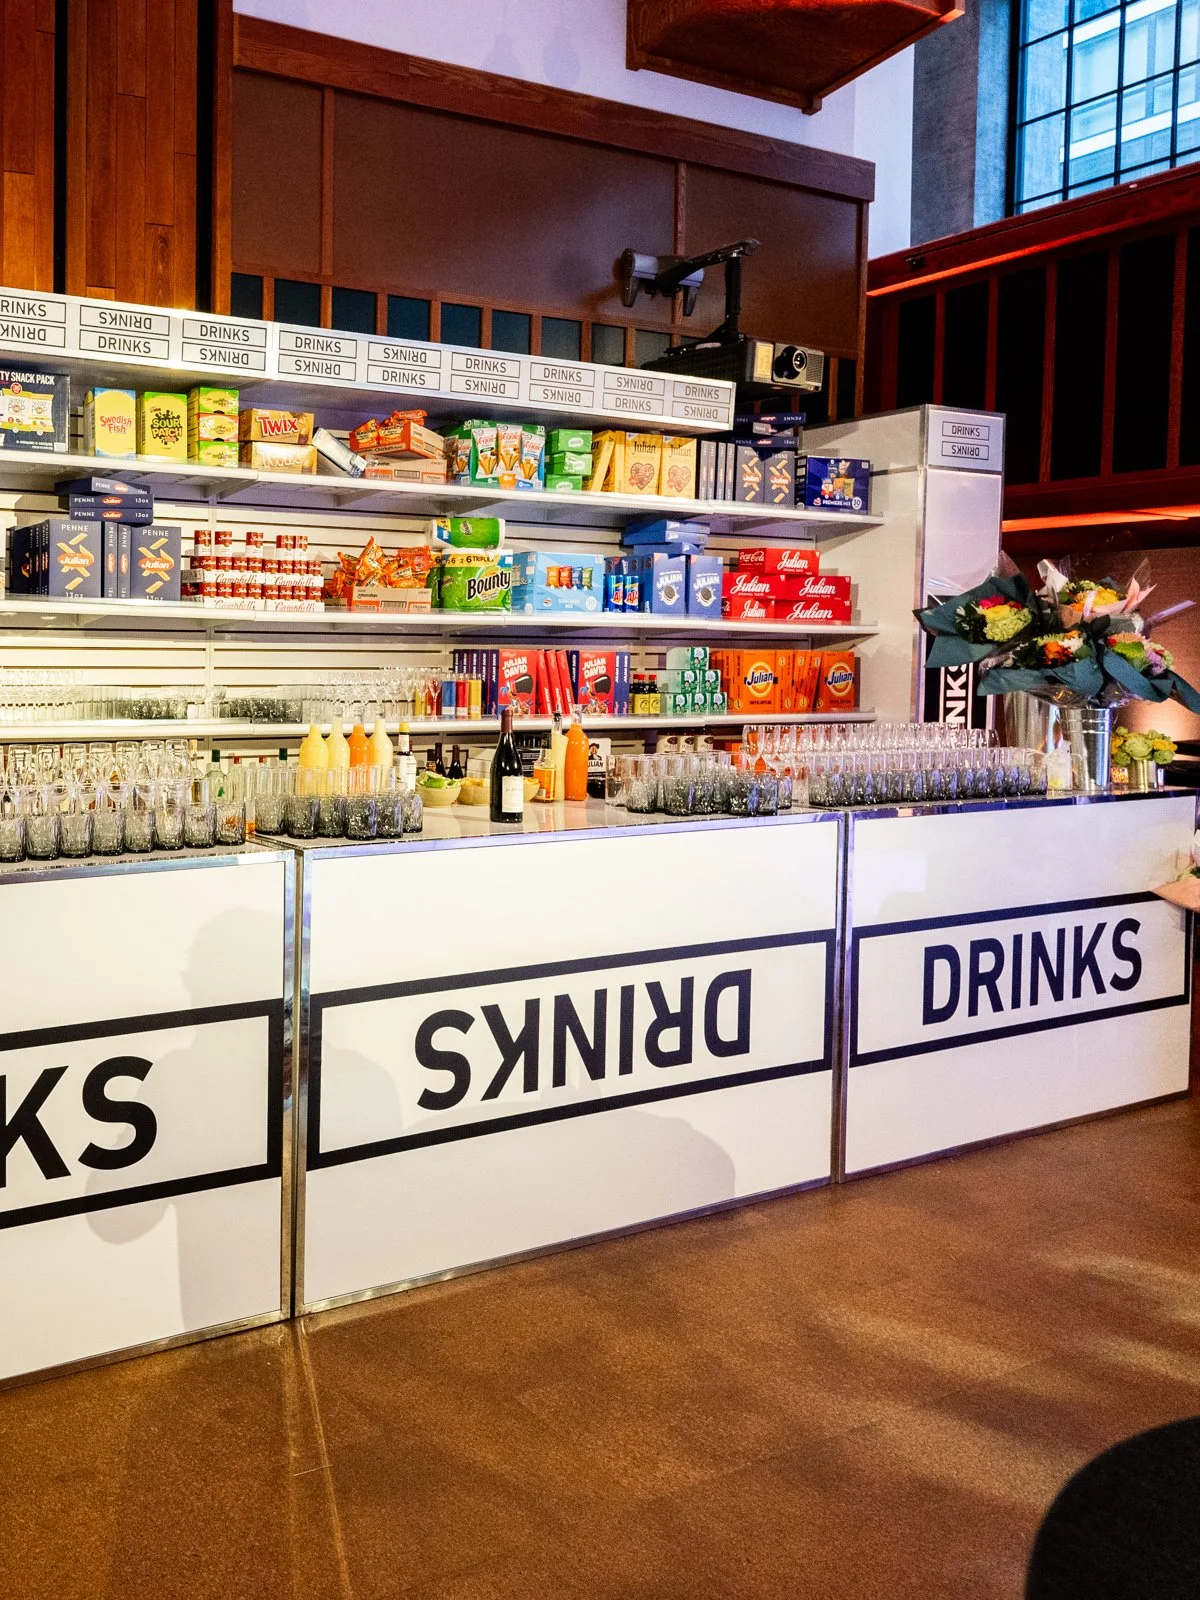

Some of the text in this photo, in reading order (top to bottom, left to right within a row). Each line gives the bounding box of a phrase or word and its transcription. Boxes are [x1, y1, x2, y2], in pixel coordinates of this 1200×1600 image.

[98, 311, 152, 330] DRINKS
[199, 324, 250, 342] DRINKS
[97, 335, 151, 354] DRINKS
[295, 336, 342, 353] DRINKS
[199, 347, 250, 365] DRINKS
[383, 347, 427, 364] DRINKS
[294, 359, 341, 376] DRINKS
[465, 357, 507, 373] DRINKS
[11, 372, 35, 383] SNACK
[36, 375, 55, 385] PACK
[382, 369, 426, 386] DRINKS
[543, 367, 582, 383] DRINKS
[464, 379, 506, 395] DRINKS
[616, 376, 653, 392] DRINKS
[542, 388, 581, 403] DRINKS
[684, 385, 720, 400] DRINKS
[615, 396, 652, 412] DRINKS
[683, 404, 719, 420] DRINKS
[100, 416, 132, 426] Swedish
[108, 424, 126, 433] Fish
[152, 419, 180, 428] SOUR
[257, 415, 298, 435] Twix
[152, 428, 182, 438] PATCH
[951, 424, 981, 438] DRINKS
[632, 441, 656, 454] Julian
[669, 444, 691, 457] Julian
[951, 444, 980, 456] DRINKS
[61, 524, 88, 532] PENNE
[142, 529, 169, 537] PENNE
[60, 556, 89, 565] Julian
[141, 561, 170, 569] Julian
[777, 551, 809, 570] Julian
[467, 571, 511, 600] Bounty
[730, 575, 770, 594] Julian
[799, 577, 836, 596] Julian
[741, 600, 766, 618] Julian
[786, 601, 832, 620] Julian
[502, 657, 527, 670] JULIAN
[504, 665, 528, 678] DAVID
[582, 657, 606, 670] JULIAN
[584, 666, 606, 679] DAVID
[746, 672, 773, 686] Julian
[827, 671, 853, 685] Julian
[922, 917, 1143, 1026] DRINKS
[414, 968, 752, 1112] DRINKS
